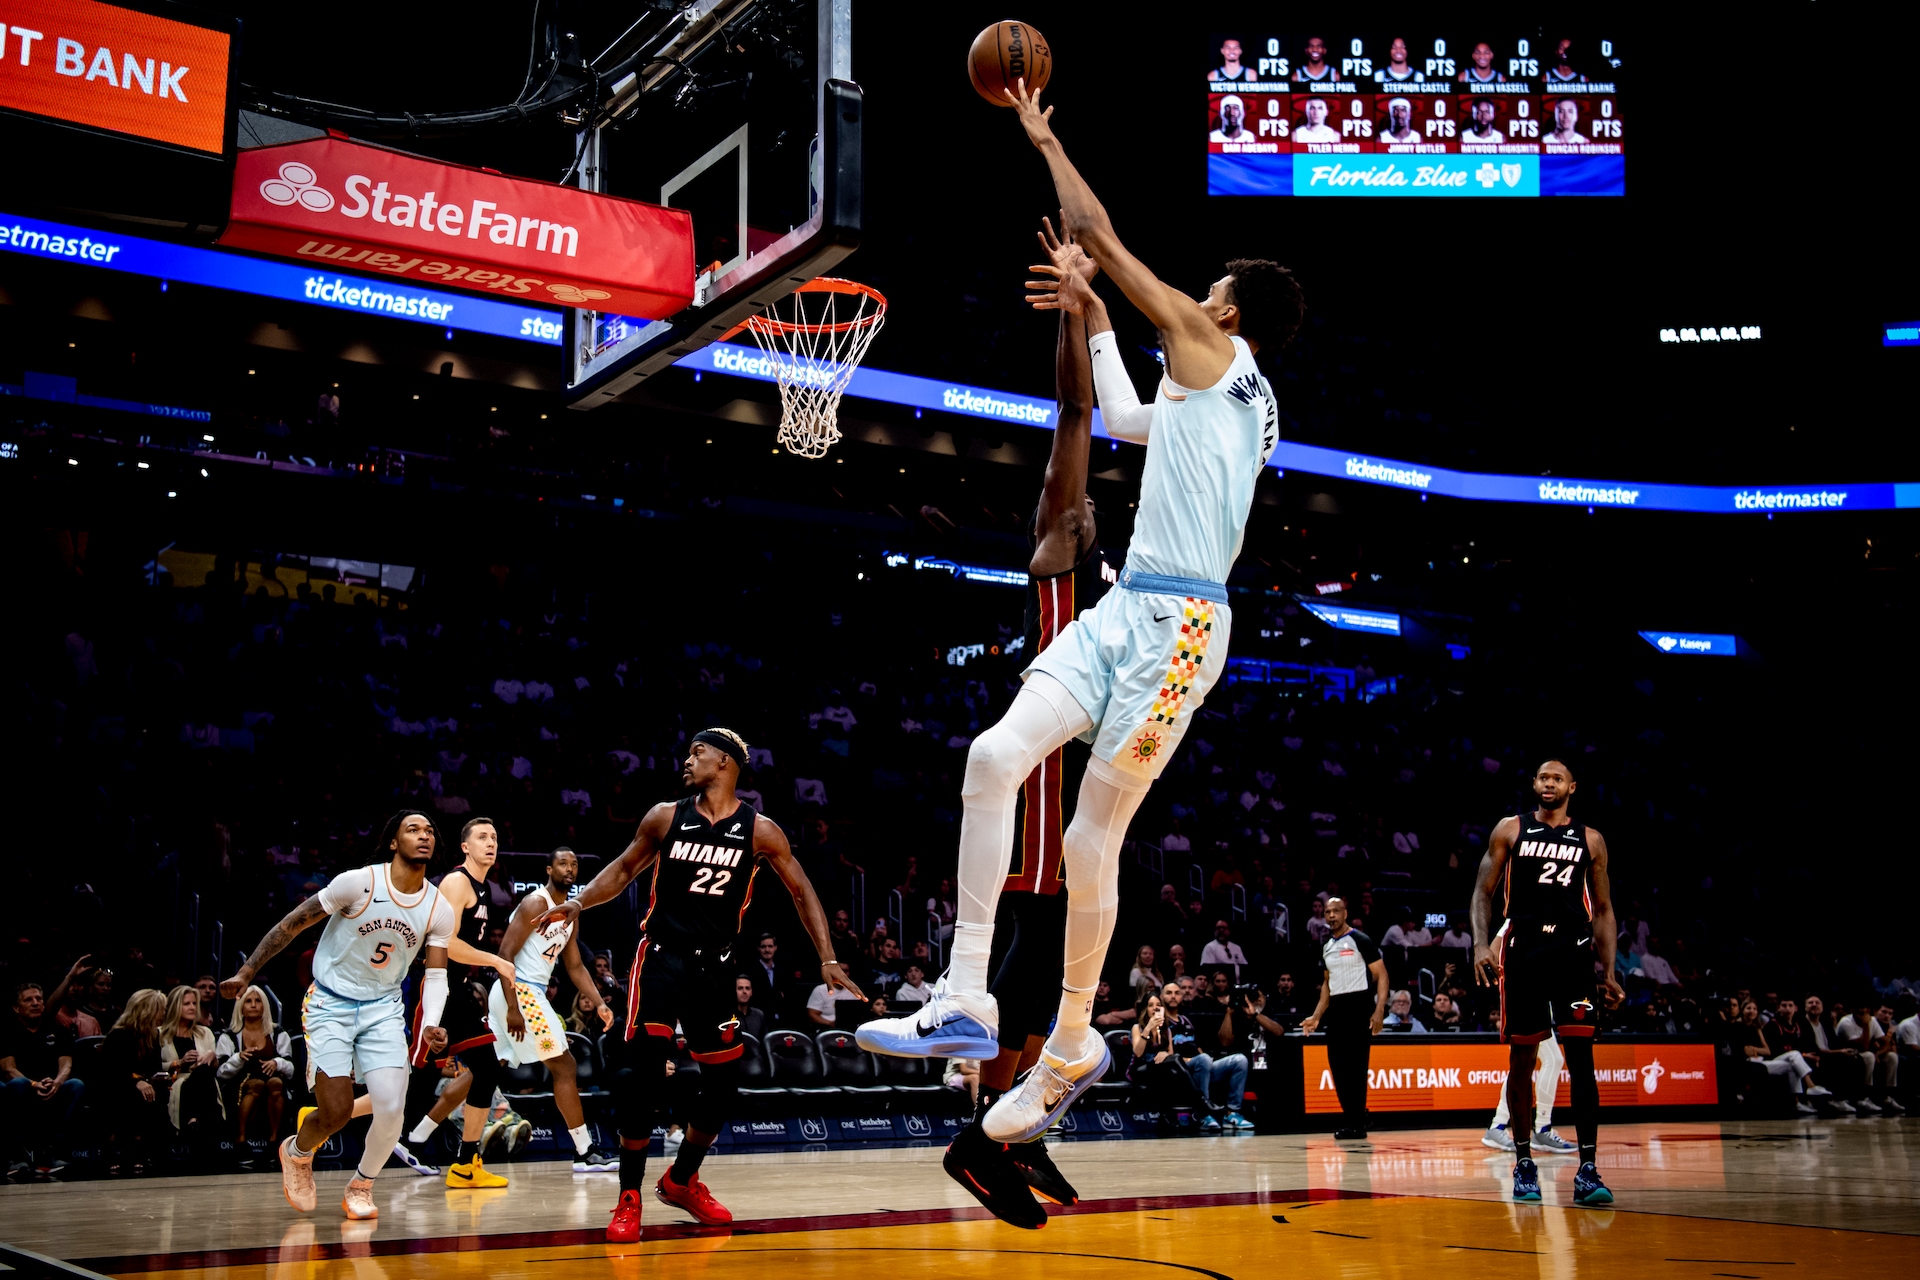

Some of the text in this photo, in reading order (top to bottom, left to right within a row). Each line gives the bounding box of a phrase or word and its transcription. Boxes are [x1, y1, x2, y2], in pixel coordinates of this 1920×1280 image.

[1009, 25, 1025, 78] Wilson
[1268, 38, 1279, 56] 0
[1351, 38, 1363, 56] 0
[1434, 39, 1446, 57] 0
[1518, 39, 1529, 57] 0
[0, 22, 190, 103] T BANK
[1259, 58, 1289, 76] PTS
[1342, 58, 1372, 76] PTS
[1425, 58, 1456, 76] PTS
[1509, 58, 1539, 76] PTS
[1210, 82, 1238, 93] VICTOR
[1310, 82, 1357, 93] CHRIS PAUL
[1383, 82, 1451, 93] STEPHON CASTLE
[1471, 82, 1530, 93] DEVIN VASSELL
[1547, 82, 1616, 93] HARRISON BARNE
[1268, 99, 1279, 117] 0
[1351, 99, 1363, 117] 0
[1434, 99, 1446, 117] 0
[1518, 99, 1529, 117] 0
[1601, 99, 1612, 117] 0
[1259, 119, 1289, 137] PTS
[1342, 119, 1372, 137] PTS
[1425, 119, 1456, 137] PTS
[1509, 119, 1539, 137] PTS
[1592, 119, 1622, 137] PTS
[1244, 143, 1278, 153] ADEBAYO
[1307, 143, 1360, 153] TYLER HERRO
[1388, 143, 1446, 153] JIMMY BUTLER
[1461, 143, 1497, 154] HAYWOOD
[1546, 143, 1621, 154] DUNCAN ROBINSON
[1310, 163, 1467, 187] Florida Blue
[304, 277, 454, 321] ticketmaster
[713, 347, 834, 386] ticketmaster
[943, 388, 1051, 423] ticketmaster
[1345, 457, 1432, 489] ticketmaster
[1538, 482, 1639, 506] ticketmaster
[1733, 490, 1847, 511] ticketmaster
[1680, 638, 1711, 652] Kaseya
[669, 840, 744, 868] MIAMI
[1519, 840, 1583, 863] MIAMI
[688, 867, 732, 896] 22
[1538, 862, 1575, 887] 24
[358, 919, 383, 937] SAN
[1424, 914, 1447, 925] 360
[370, 942, 395, 968] 5
[1319, 1068, 1461, 1090] ARANT BANK
[1468, 1069, 1510, 1084] OFFICIA
[1612, 1068, 1638, 1082] HEAT
[732, 1125, 748, 1133] ONE
[752, 1121, 786, 1132] Sotheby's
[841, 1121, 856, 1129] ONE
[859, 1118, 892, 1127] Sotheby's
[944, 1118, 958, 1126] ONE
